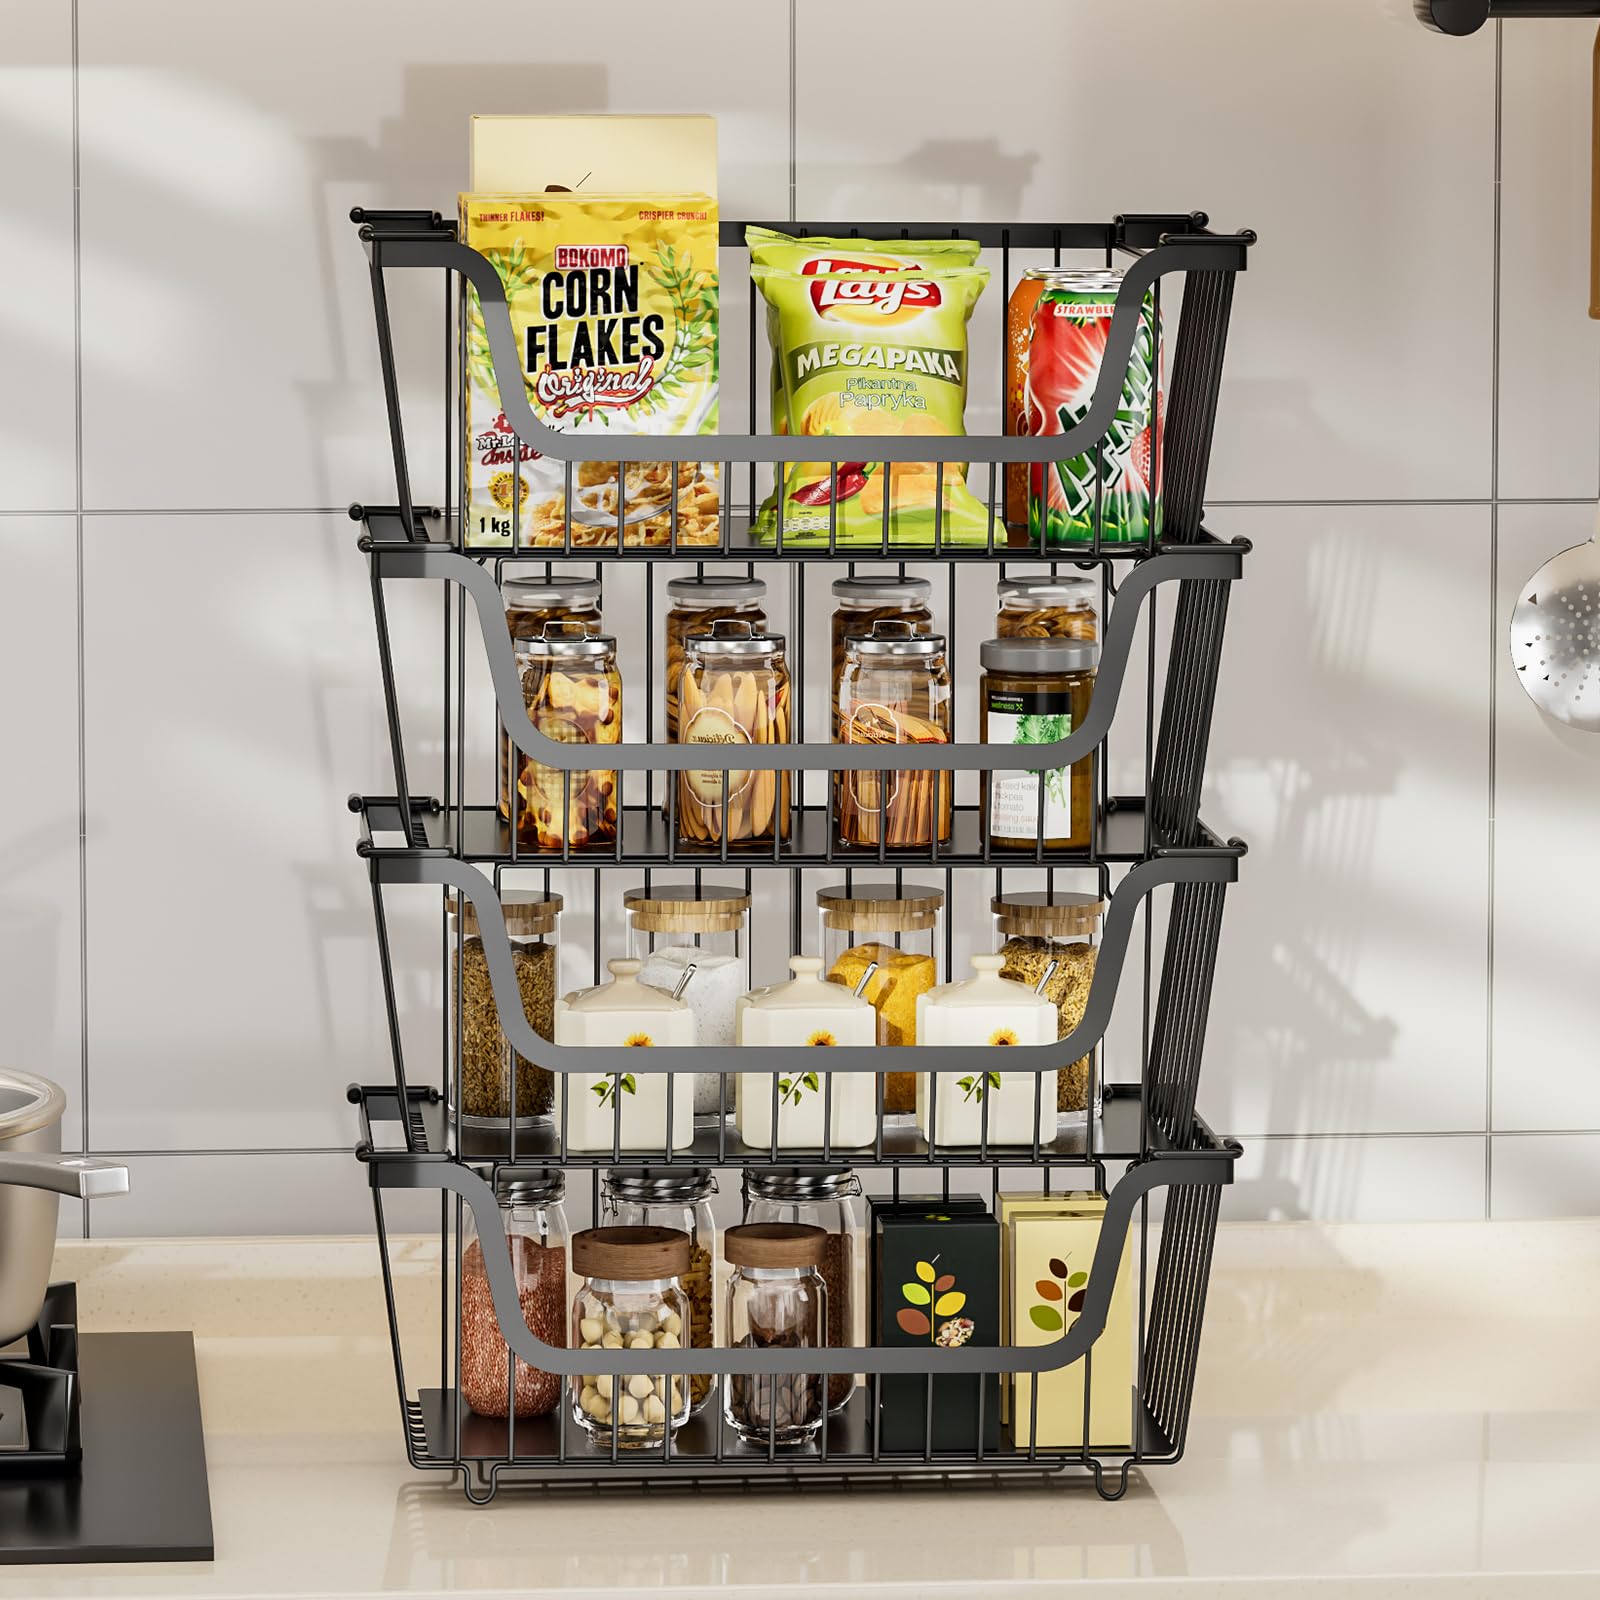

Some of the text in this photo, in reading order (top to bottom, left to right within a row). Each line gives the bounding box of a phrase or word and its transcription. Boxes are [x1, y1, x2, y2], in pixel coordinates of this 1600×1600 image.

[510, 211, 544, 222] FLAKES!
[639, 210, 674, 220] CRISPIER
[558, 247, 627, 267] BOKOMO
[542, 264, 639, 320] CORN
[526, 314, 665, 373] FLAKES
[797, 343, 961, 381] MEGAPAKA
[537, 356, 655, 413] Original
[846, 377, 917, 391] Pikantna
[839, 391, 927, 411] Papryka
[480, 517, 510, 537] 1 kg
